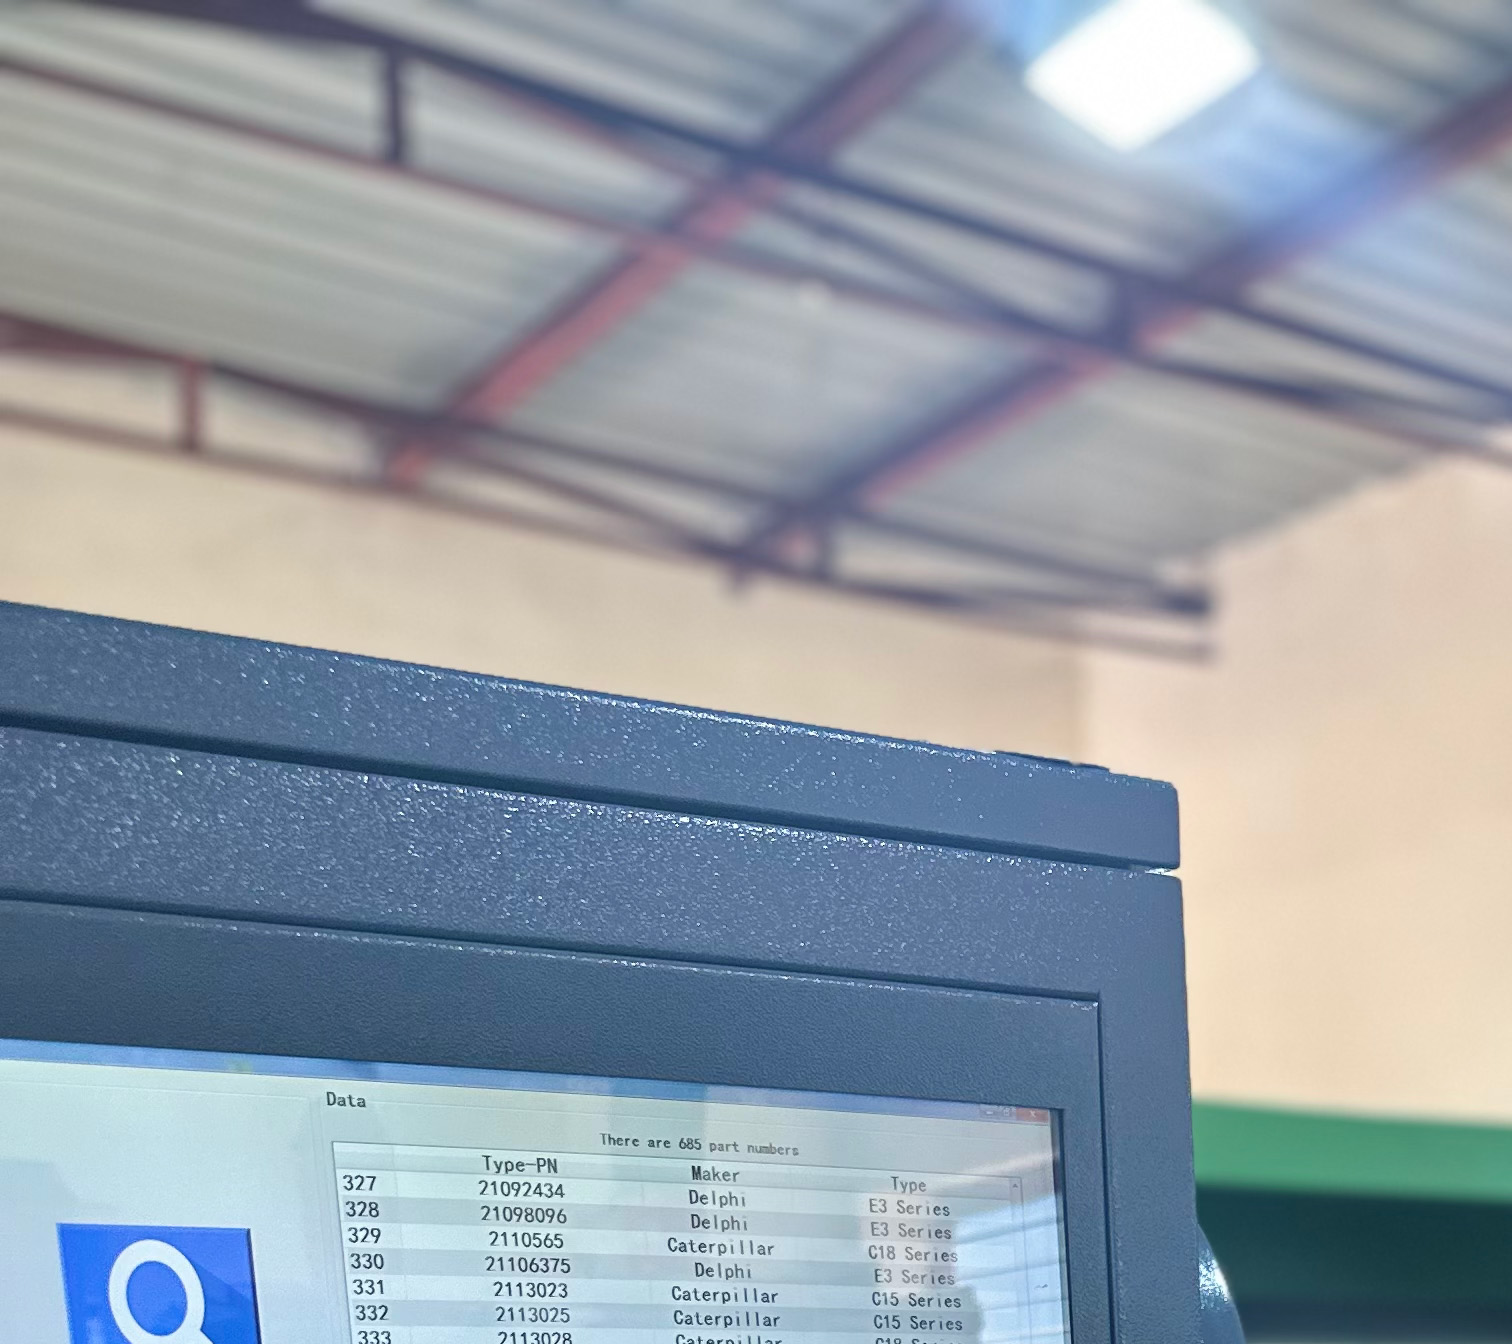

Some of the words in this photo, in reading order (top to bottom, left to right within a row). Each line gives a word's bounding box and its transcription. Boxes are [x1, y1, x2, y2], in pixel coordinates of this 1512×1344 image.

[326, 1091, 367, 1109] Data
[599, 1132, 640, 1148] There
[647, 1139, 671, 1149] are
[678, 1137, 702, 1150] 685
[709, 1141, 739, 1153] part
[746, 1143, 799, 1156] numbers
[482, 1155, 559, 1175] Type-PN
[691, 1166, 740, 1183] Maker
[890, 1176, 927, 1194] Type
[342, 1175, 377, 1192] 327
[478, 1180, 565, 1199] 21092434
[688, 1189, 746, 1208] Delphi
[869, 1199, 888, 1213] E3
[896, 1200, 950, 1218] Series
[345, 1200, 380, 1218] 328
[480, 1205, 568, 1224] 21098096
[690, 1213, 748, 1232] Delphi
[870, 1222, 889, 1237] E3
[898, 1223, 952, 1241] Series
[347, 1227, 381, 1244] 329
[488, 1231, 564, 1249] 2110565
[667, 1237, 775, 1257] Caterpillar
[868, 1245, 896, 1261] C18
[904, 1246, 959, 1264] Series
[350, 1253, 384, 1270] 330
[485, 1256, 571, 1274] 21106375
[694, 1262, 752, 1281] Delphi
[874, 1268, 893, 1283] E3
[901, 1269, 955, 1287] Series
[352, 1279, 385, 1296] 331
[493, 1281, 568, 1299] 2113023
[671, 1286, 779, 1305] Caterpillar
[871, 1291, 900, 1307] C15
[908, 1292, 962, 1309] Series
[355, 1305, 389, 1322] 332
[495, 1306, 570, 1324] 2113025
[673, 1309, 781, 1329] Caterpillar
[873, 1314, 901, 1330] C15
[910, 1315, 963, 1332] Series
